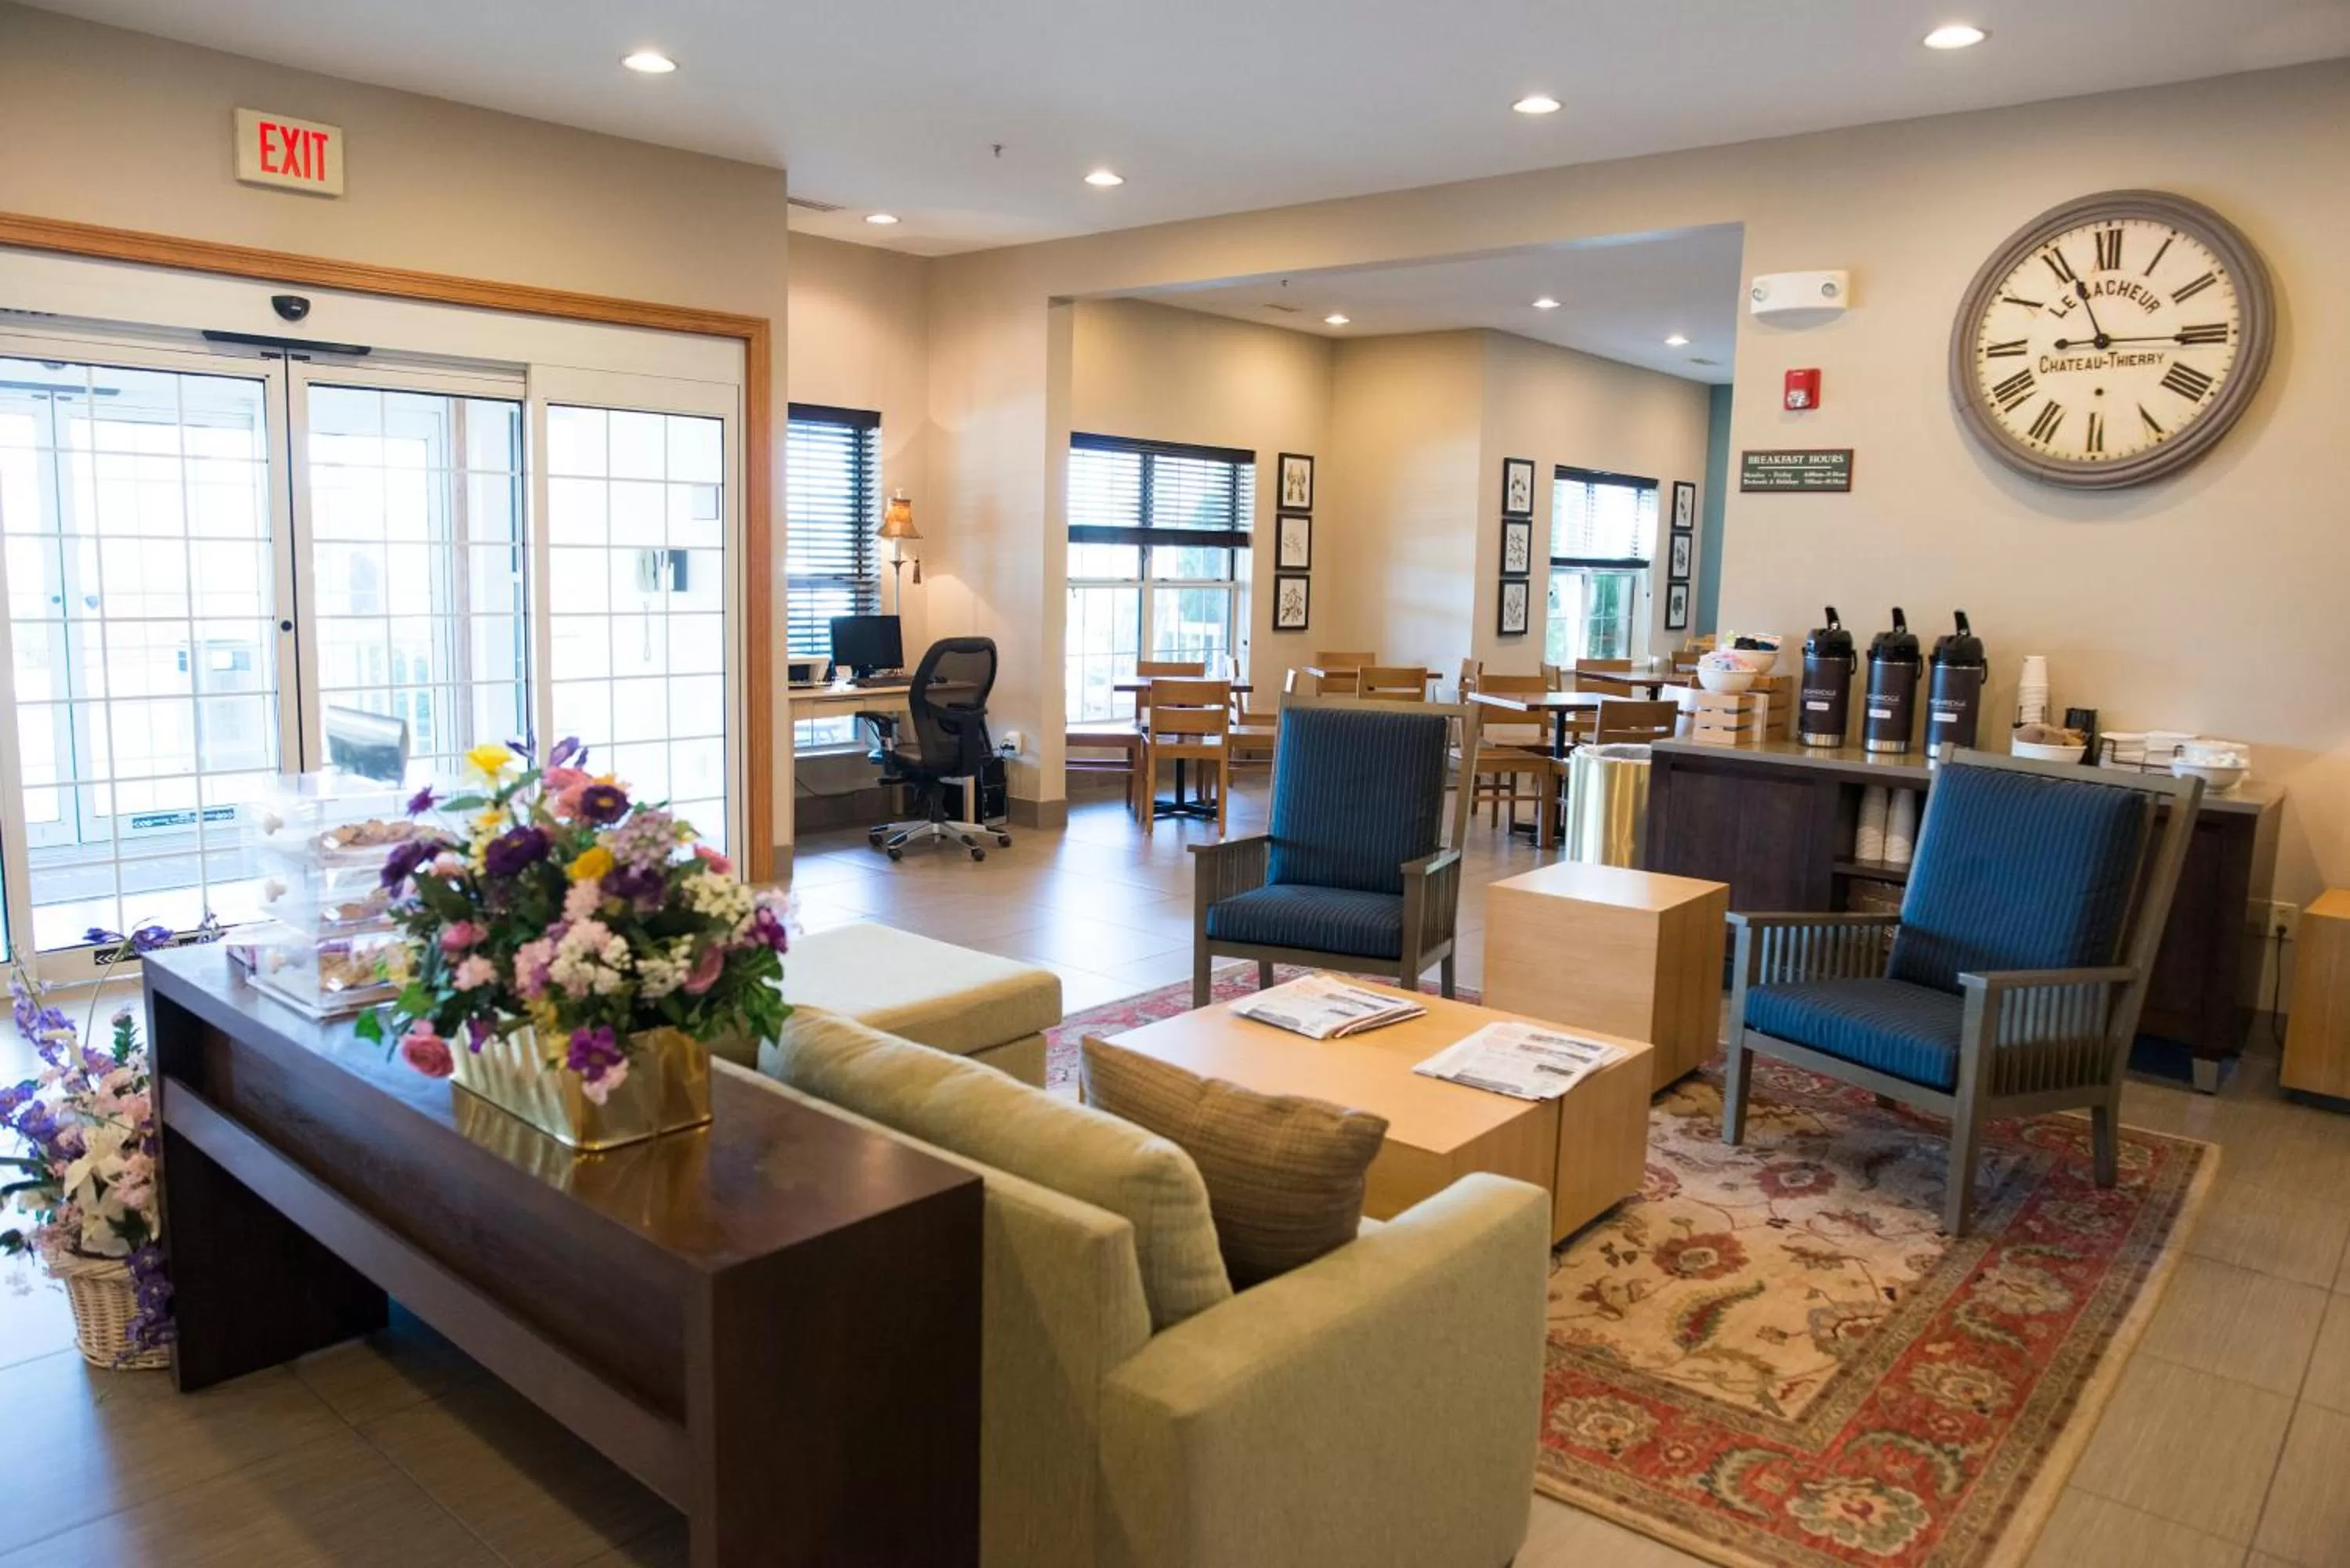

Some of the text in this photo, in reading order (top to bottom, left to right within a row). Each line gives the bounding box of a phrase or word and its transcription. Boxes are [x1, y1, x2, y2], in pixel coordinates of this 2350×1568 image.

[259, 121, 328, 182] EXIT
[2048, 294, 2077, 319] LE
[2039, 352, 2165, 374] CHATEAU-THIERRY
[1748, 454, 1844, 464] BREAKFAST HOURS
